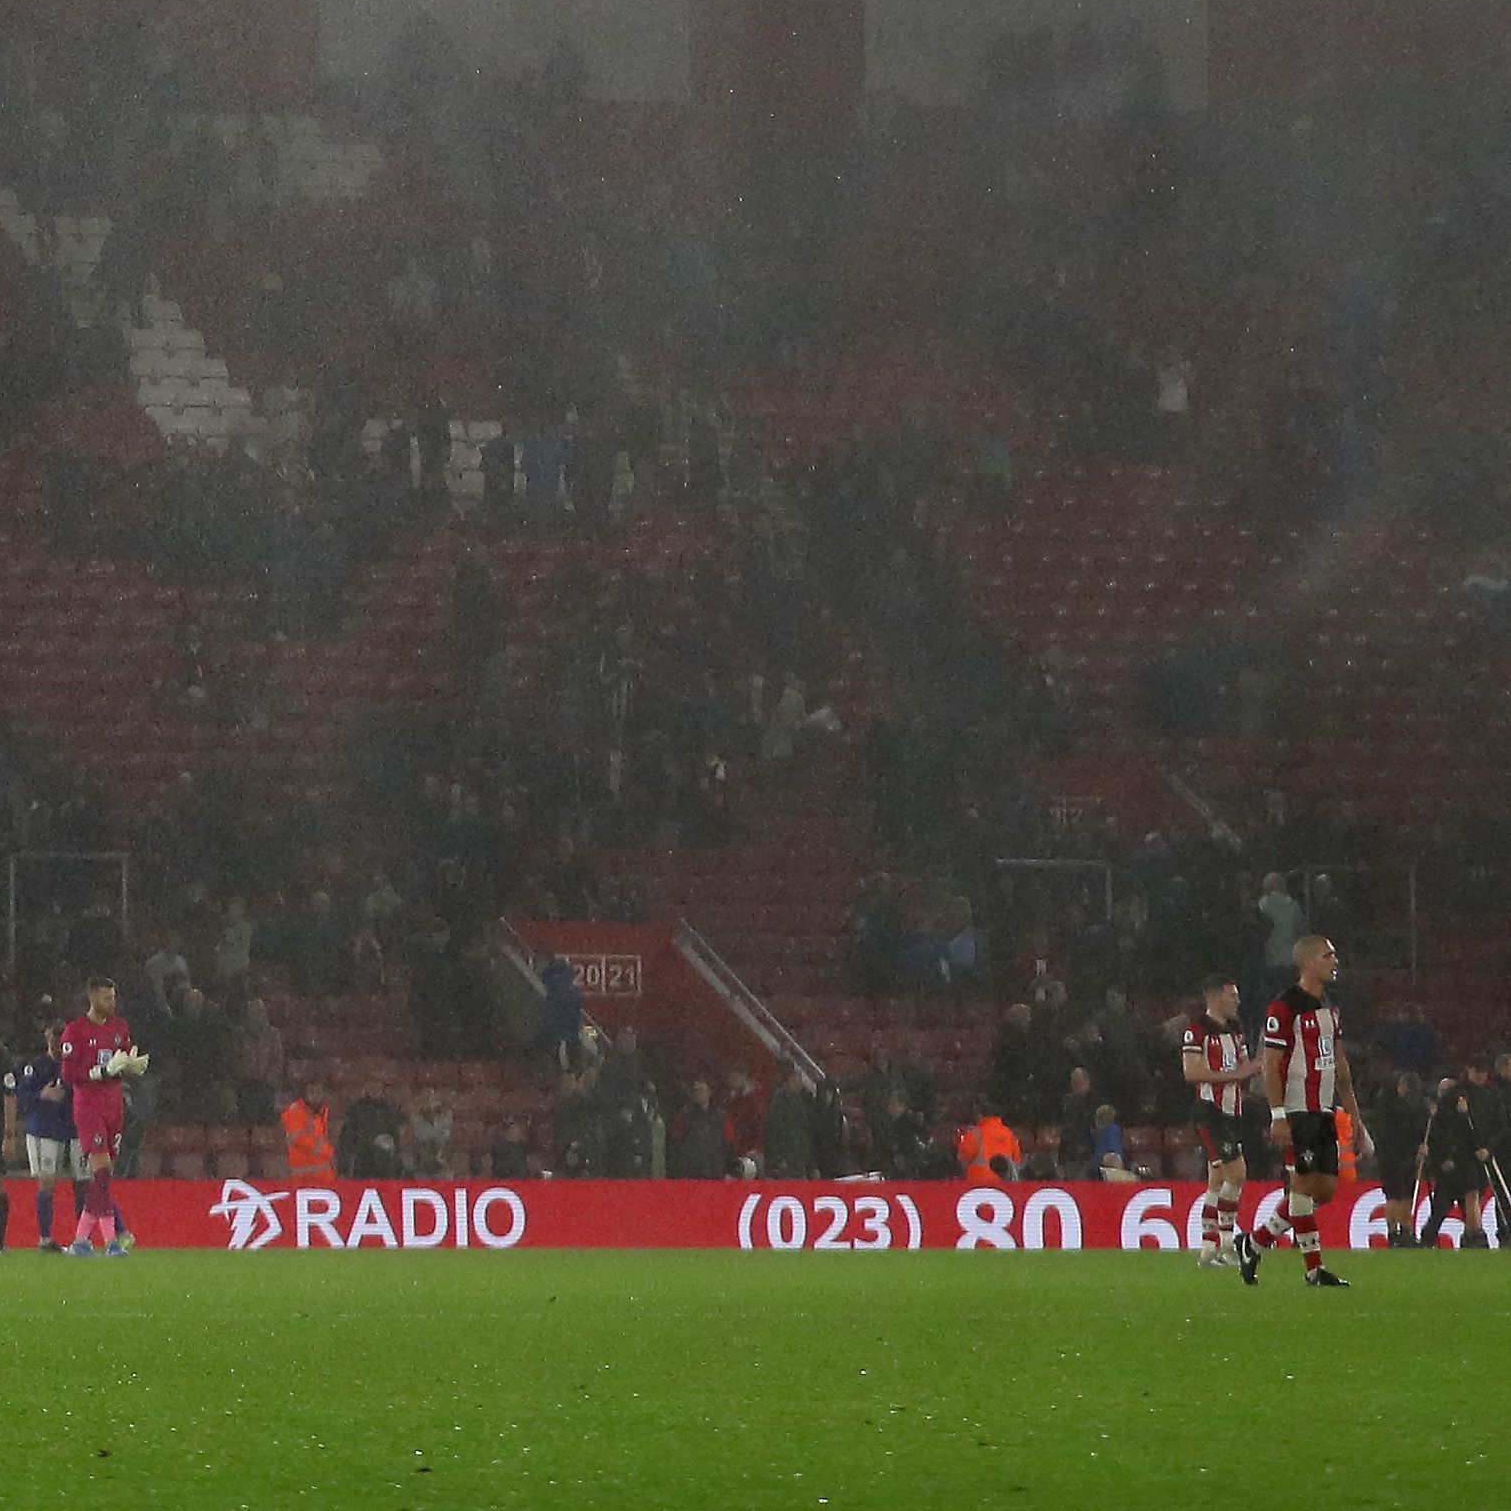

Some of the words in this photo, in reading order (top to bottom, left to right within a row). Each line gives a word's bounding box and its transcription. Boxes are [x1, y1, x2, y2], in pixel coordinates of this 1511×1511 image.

[571, 963, 599, 988] 20
[608, 964, 635, 988] 21
[295, 1187, 526, 1249] RADIO
[738, 1193, 922, 1250] (023)
[956, 1187, 1083, 1250] 80
